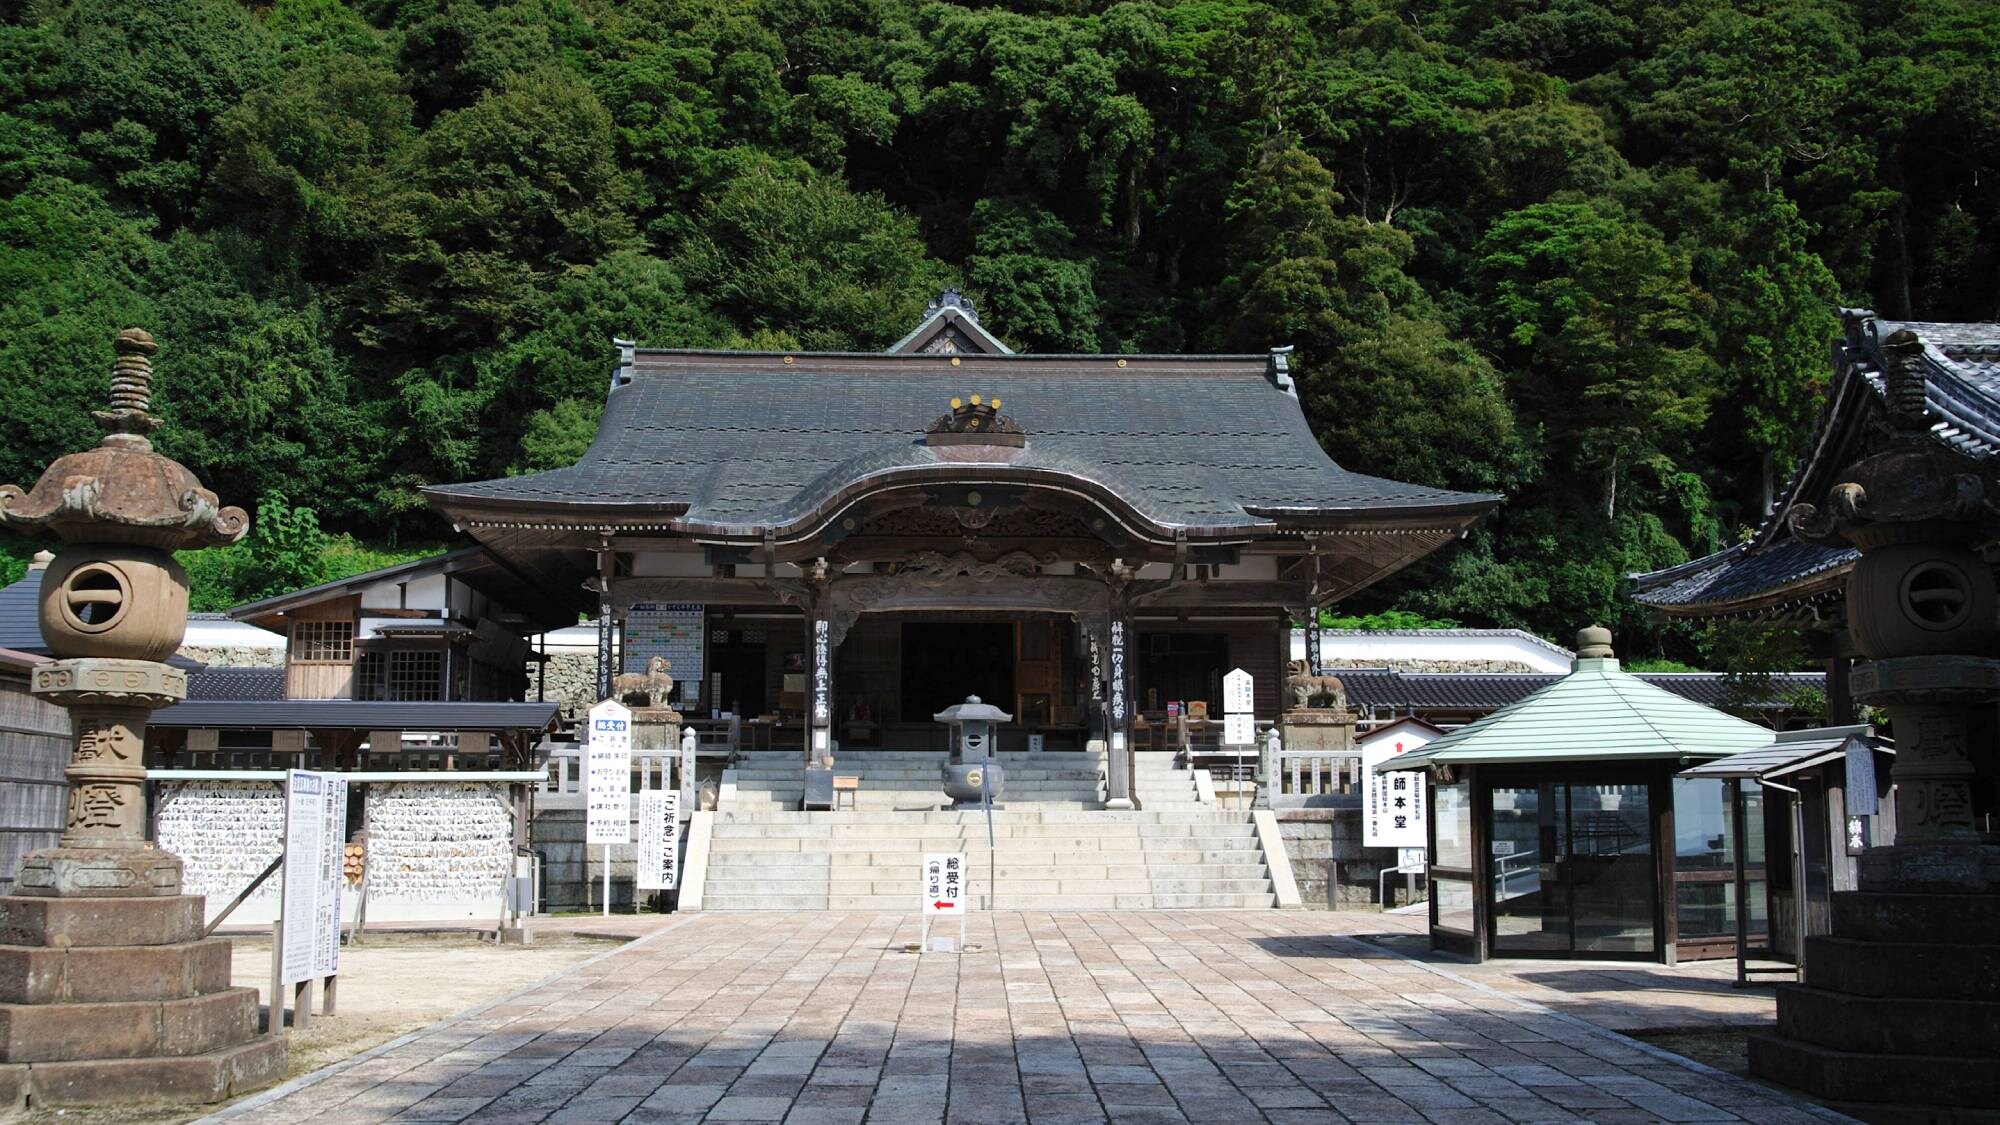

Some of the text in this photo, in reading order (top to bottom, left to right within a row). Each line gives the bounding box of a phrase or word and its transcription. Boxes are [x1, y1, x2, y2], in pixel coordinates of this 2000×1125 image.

[1393, 776, 1407, 829] 師本堂
[662, 794, 676, 884] 「ご祈念」ご案内
[929, 860, 940, 899] （帰り道）
[946, 857, 960, 899] 総受付
